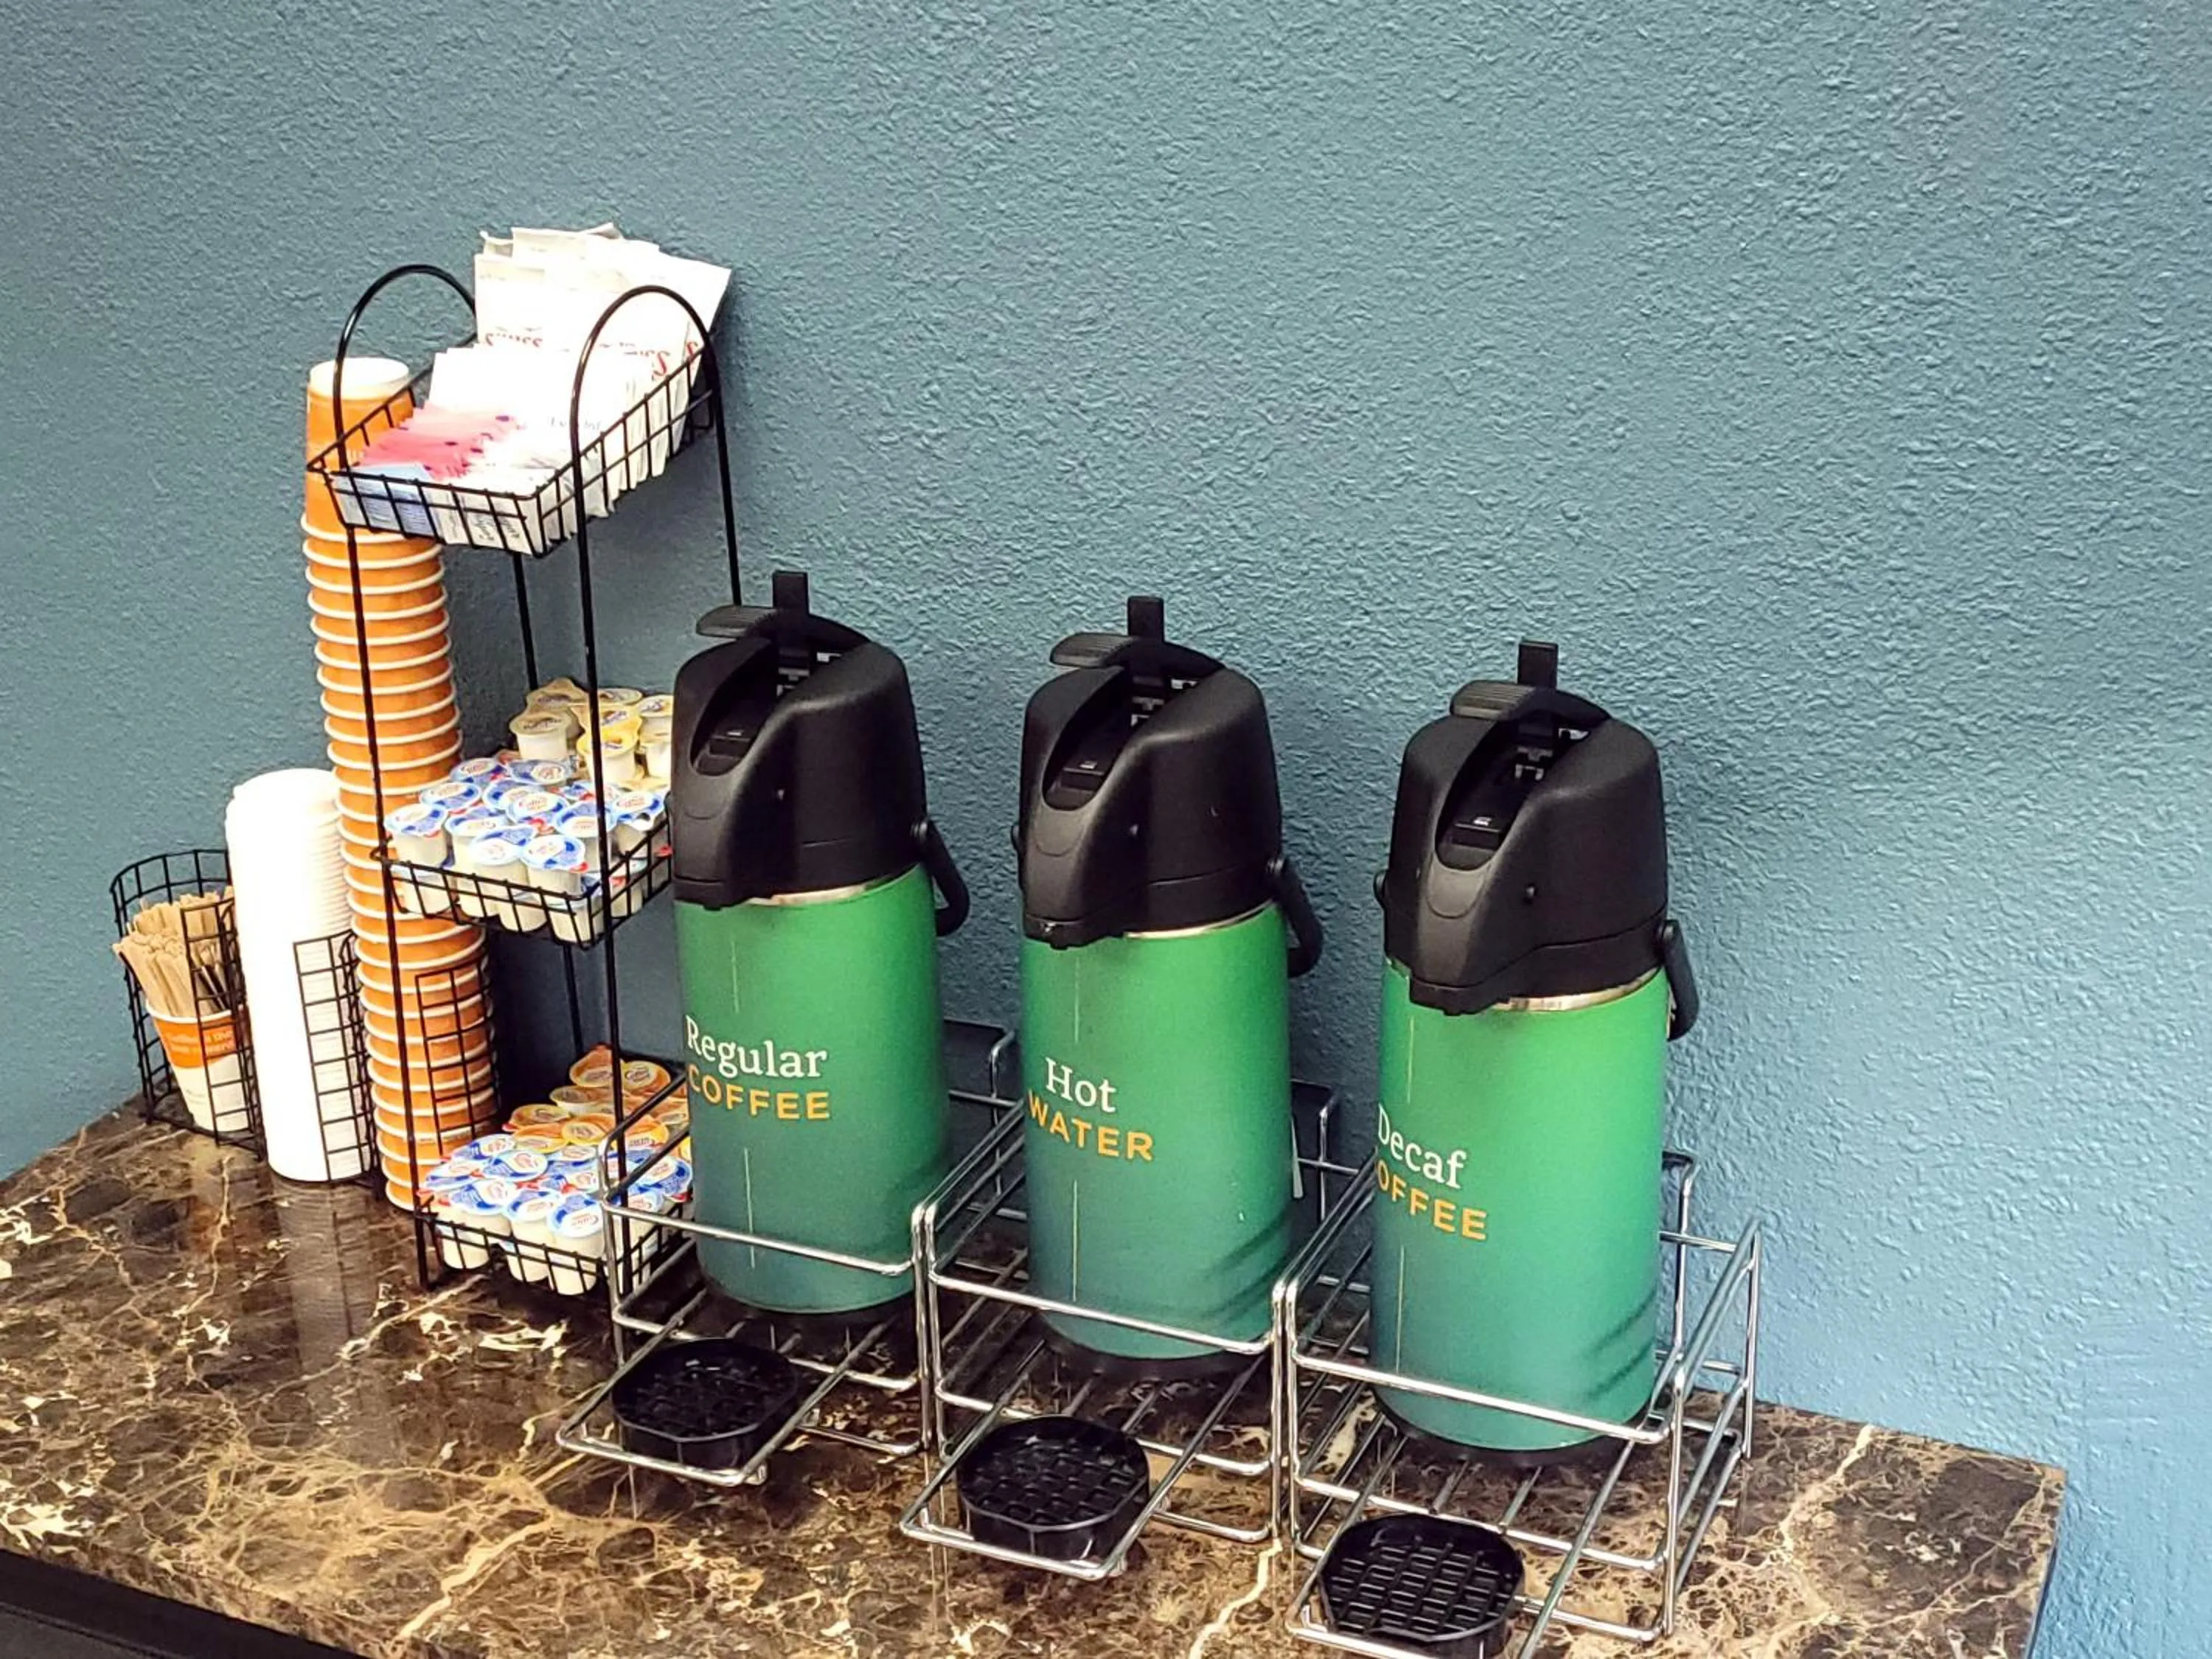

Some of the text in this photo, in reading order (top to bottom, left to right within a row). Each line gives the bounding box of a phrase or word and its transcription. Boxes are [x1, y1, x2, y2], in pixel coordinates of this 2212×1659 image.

[685, 1015, 828, 1078] Regular
[687, 1064, 830, 1119] COFFEE
[1046, 1057, 1116, 1113] Hot
[1028, 1088, 1153, 1161] WATER
[1377, 1103, 1467, 1189] Decaf
[1376, 1159, 1487, 1240] OFFEE
